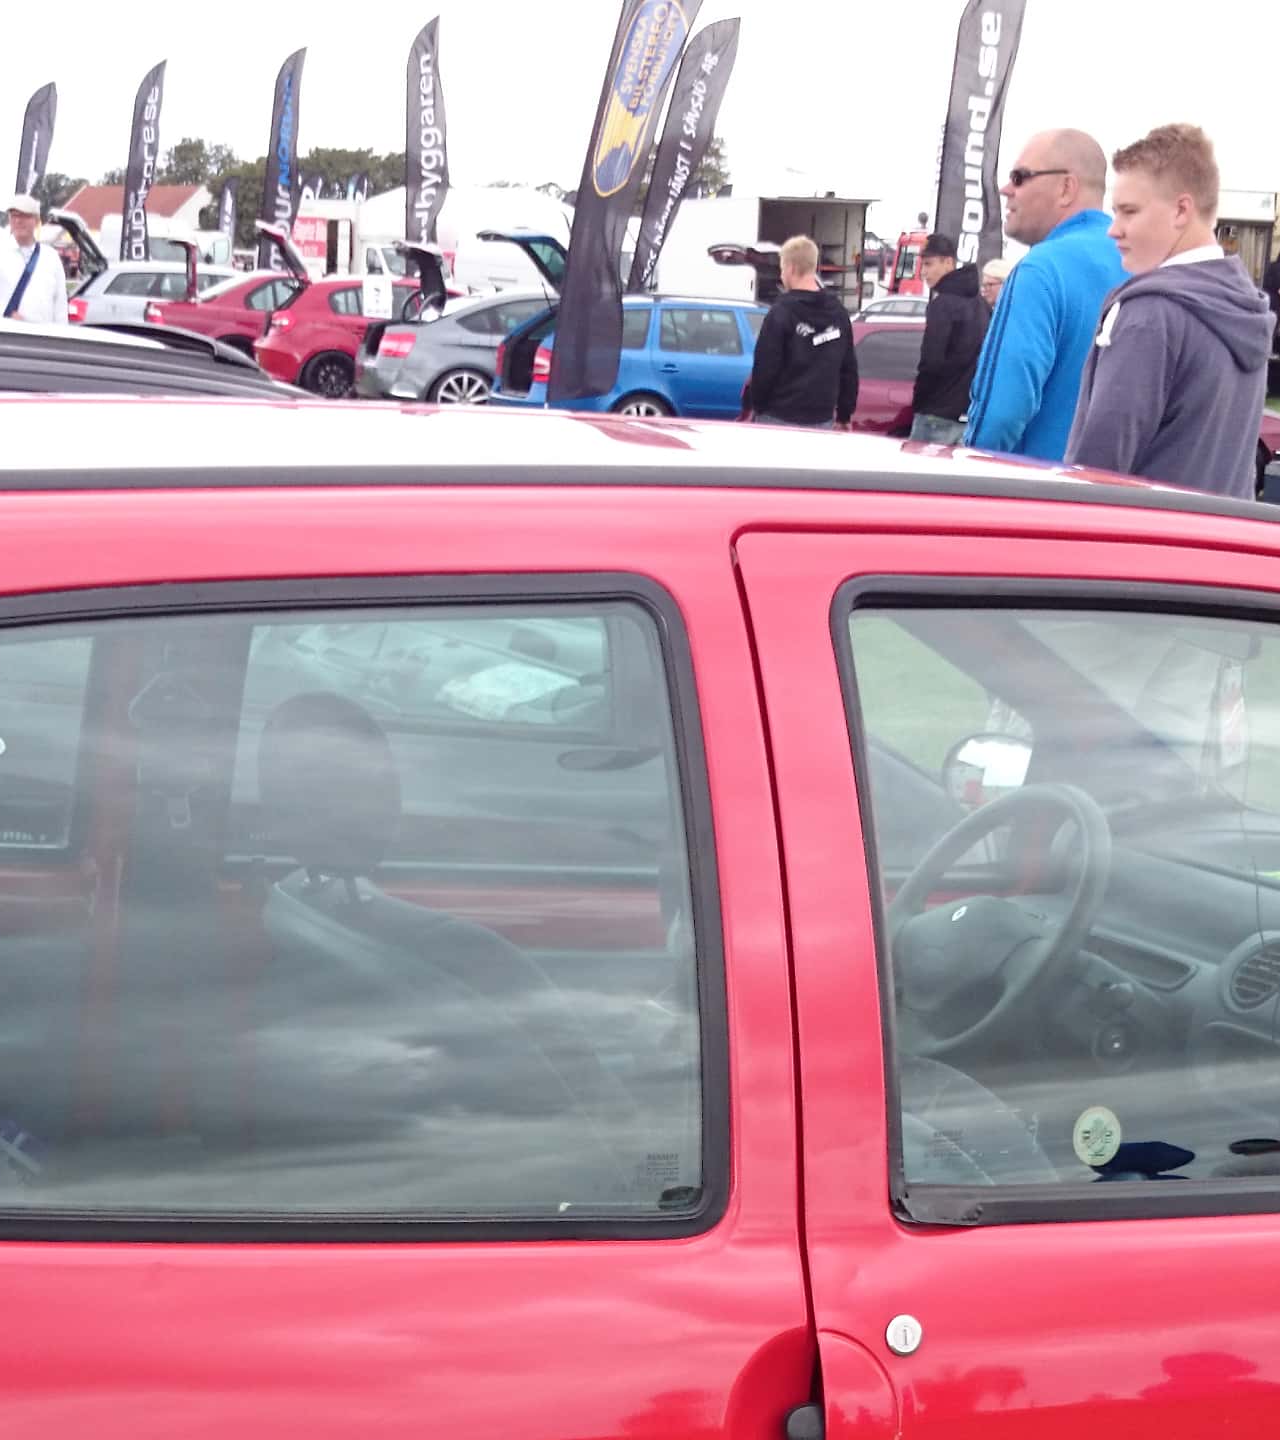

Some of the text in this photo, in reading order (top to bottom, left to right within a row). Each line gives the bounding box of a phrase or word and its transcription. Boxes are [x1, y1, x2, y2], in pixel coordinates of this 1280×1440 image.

[619, 14, 649, 94] SVENSKA
[628, 3, 669, 110] BILSTEREO
[682, 78, 708, 138] SÄVSJÖ
[701, 51, 719, 75] AB
[956, 12, 1002, 266] sound.se
